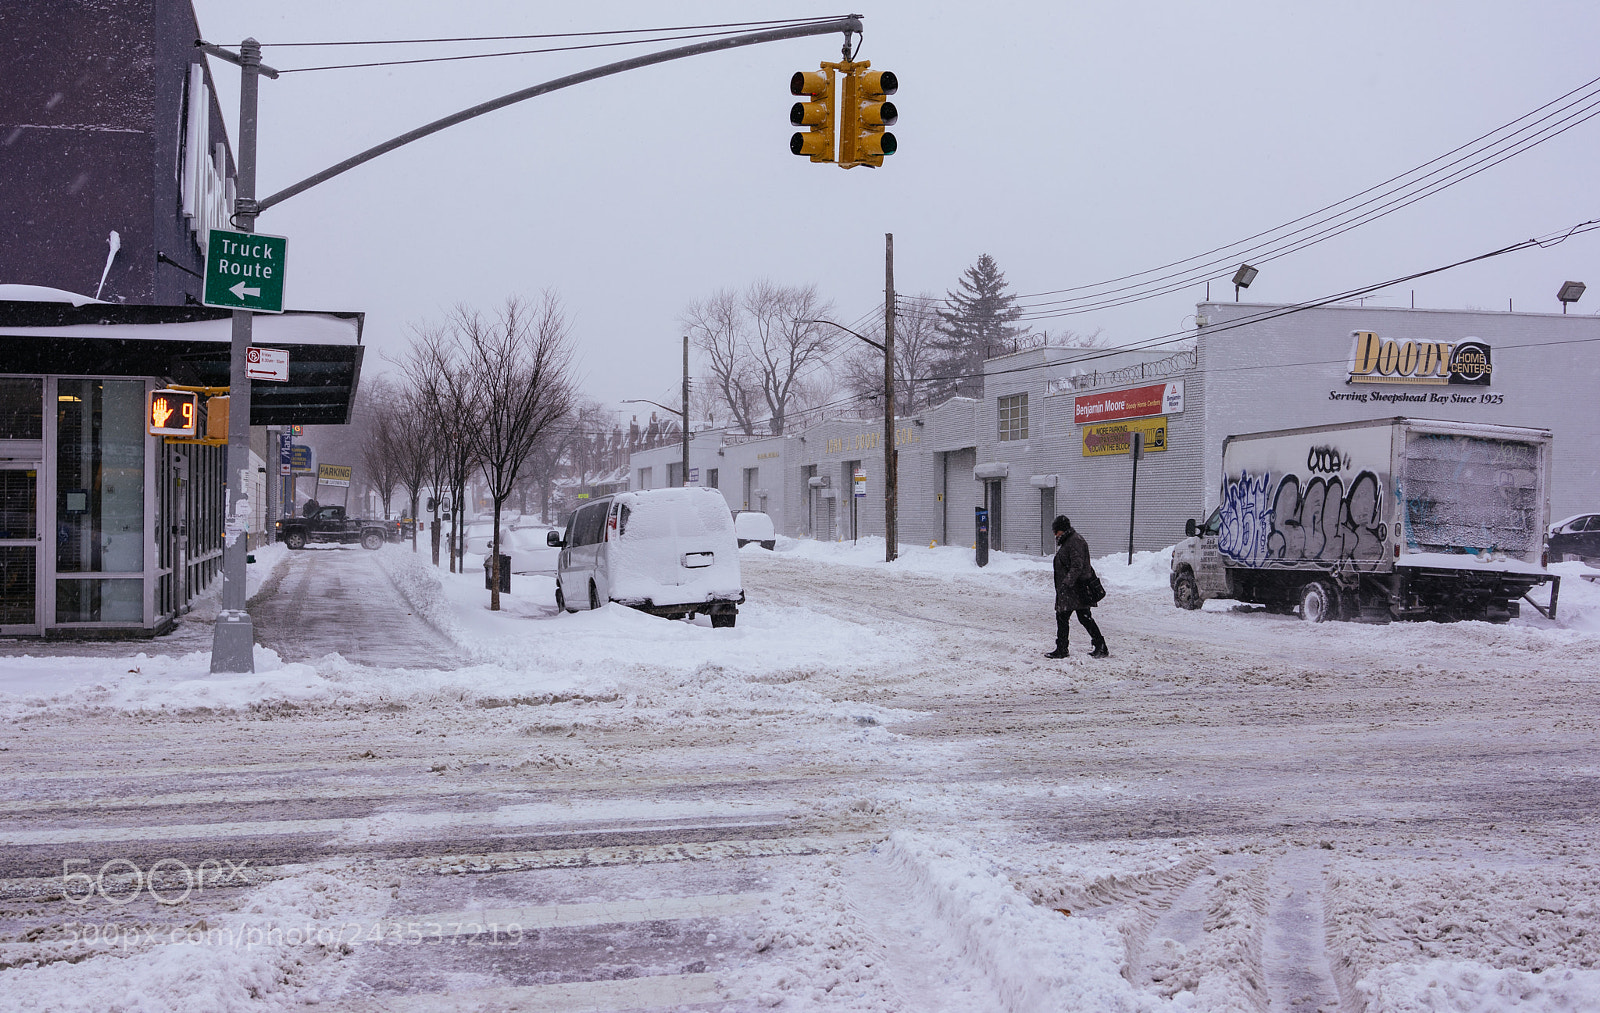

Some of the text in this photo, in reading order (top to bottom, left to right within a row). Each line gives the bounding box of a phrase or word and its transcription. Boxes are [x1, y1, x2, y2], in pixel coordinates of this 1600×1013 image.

[222, 239, 273, 259] Truck
[219, 259, 272, 279] Route
[1458, 353, 1485, 364] HOME
[1451, 363, 1492, 375] CENTERS
[1328, 391, 1504, 405] Serving Sheepshead Bay Since 1925
[182, 402, 193, 428] 9
[1076, 401, 1104, 417] Benjamin
[1104, 400, 1125, 412] Moore
[1096, 425, 1127, 435] MORE PARKING
[855, 432, 880, 450] DOODY
[896, 428, 913, 446] SON
[1092, 444, 1106, 452] DOWN
[320, 466, 350, 478] PARKING
